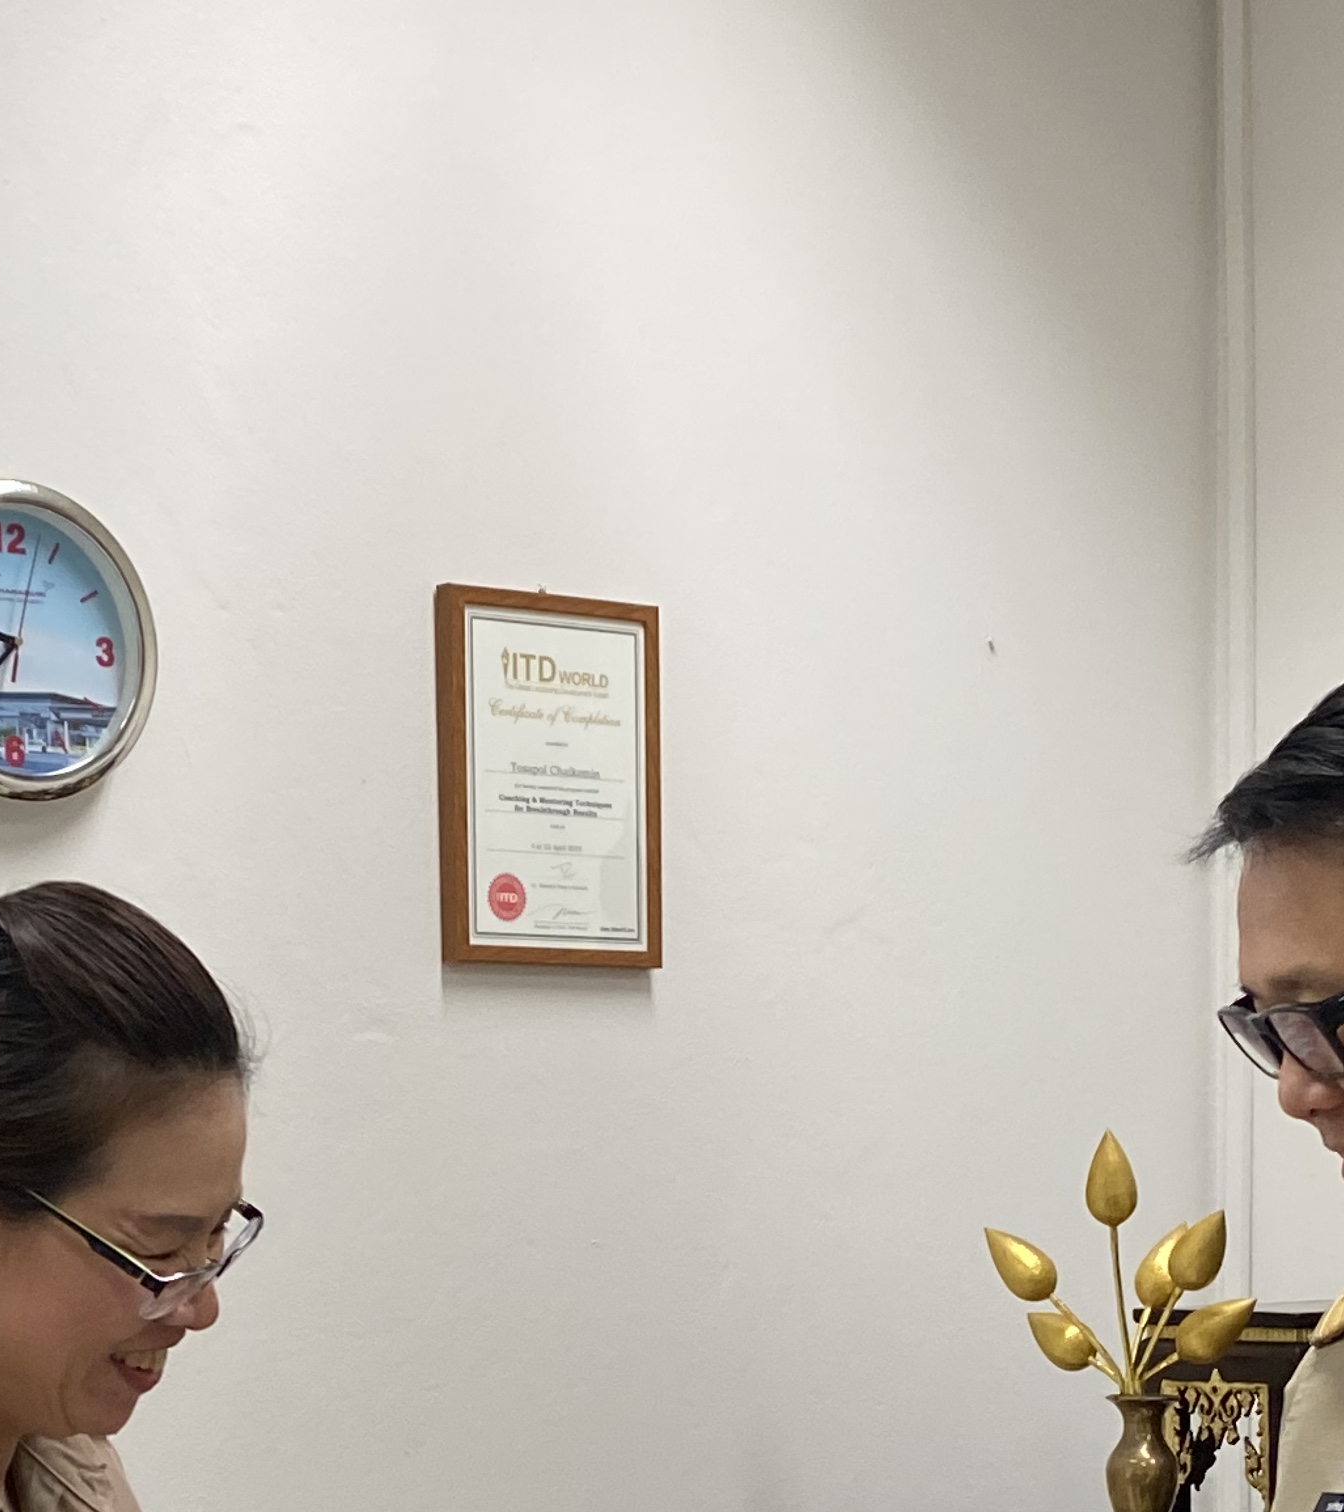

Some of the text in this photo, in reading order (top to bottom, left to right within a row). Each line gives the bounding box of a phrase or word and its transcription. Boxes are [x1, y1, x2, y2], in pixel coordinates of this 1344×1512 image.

[95, 636, 115, 667] 3
[512, 652, 609, 688] ITD WORLD
[488, 696, 544, 725] Certificate
[4, 734, 25, 767] 6
